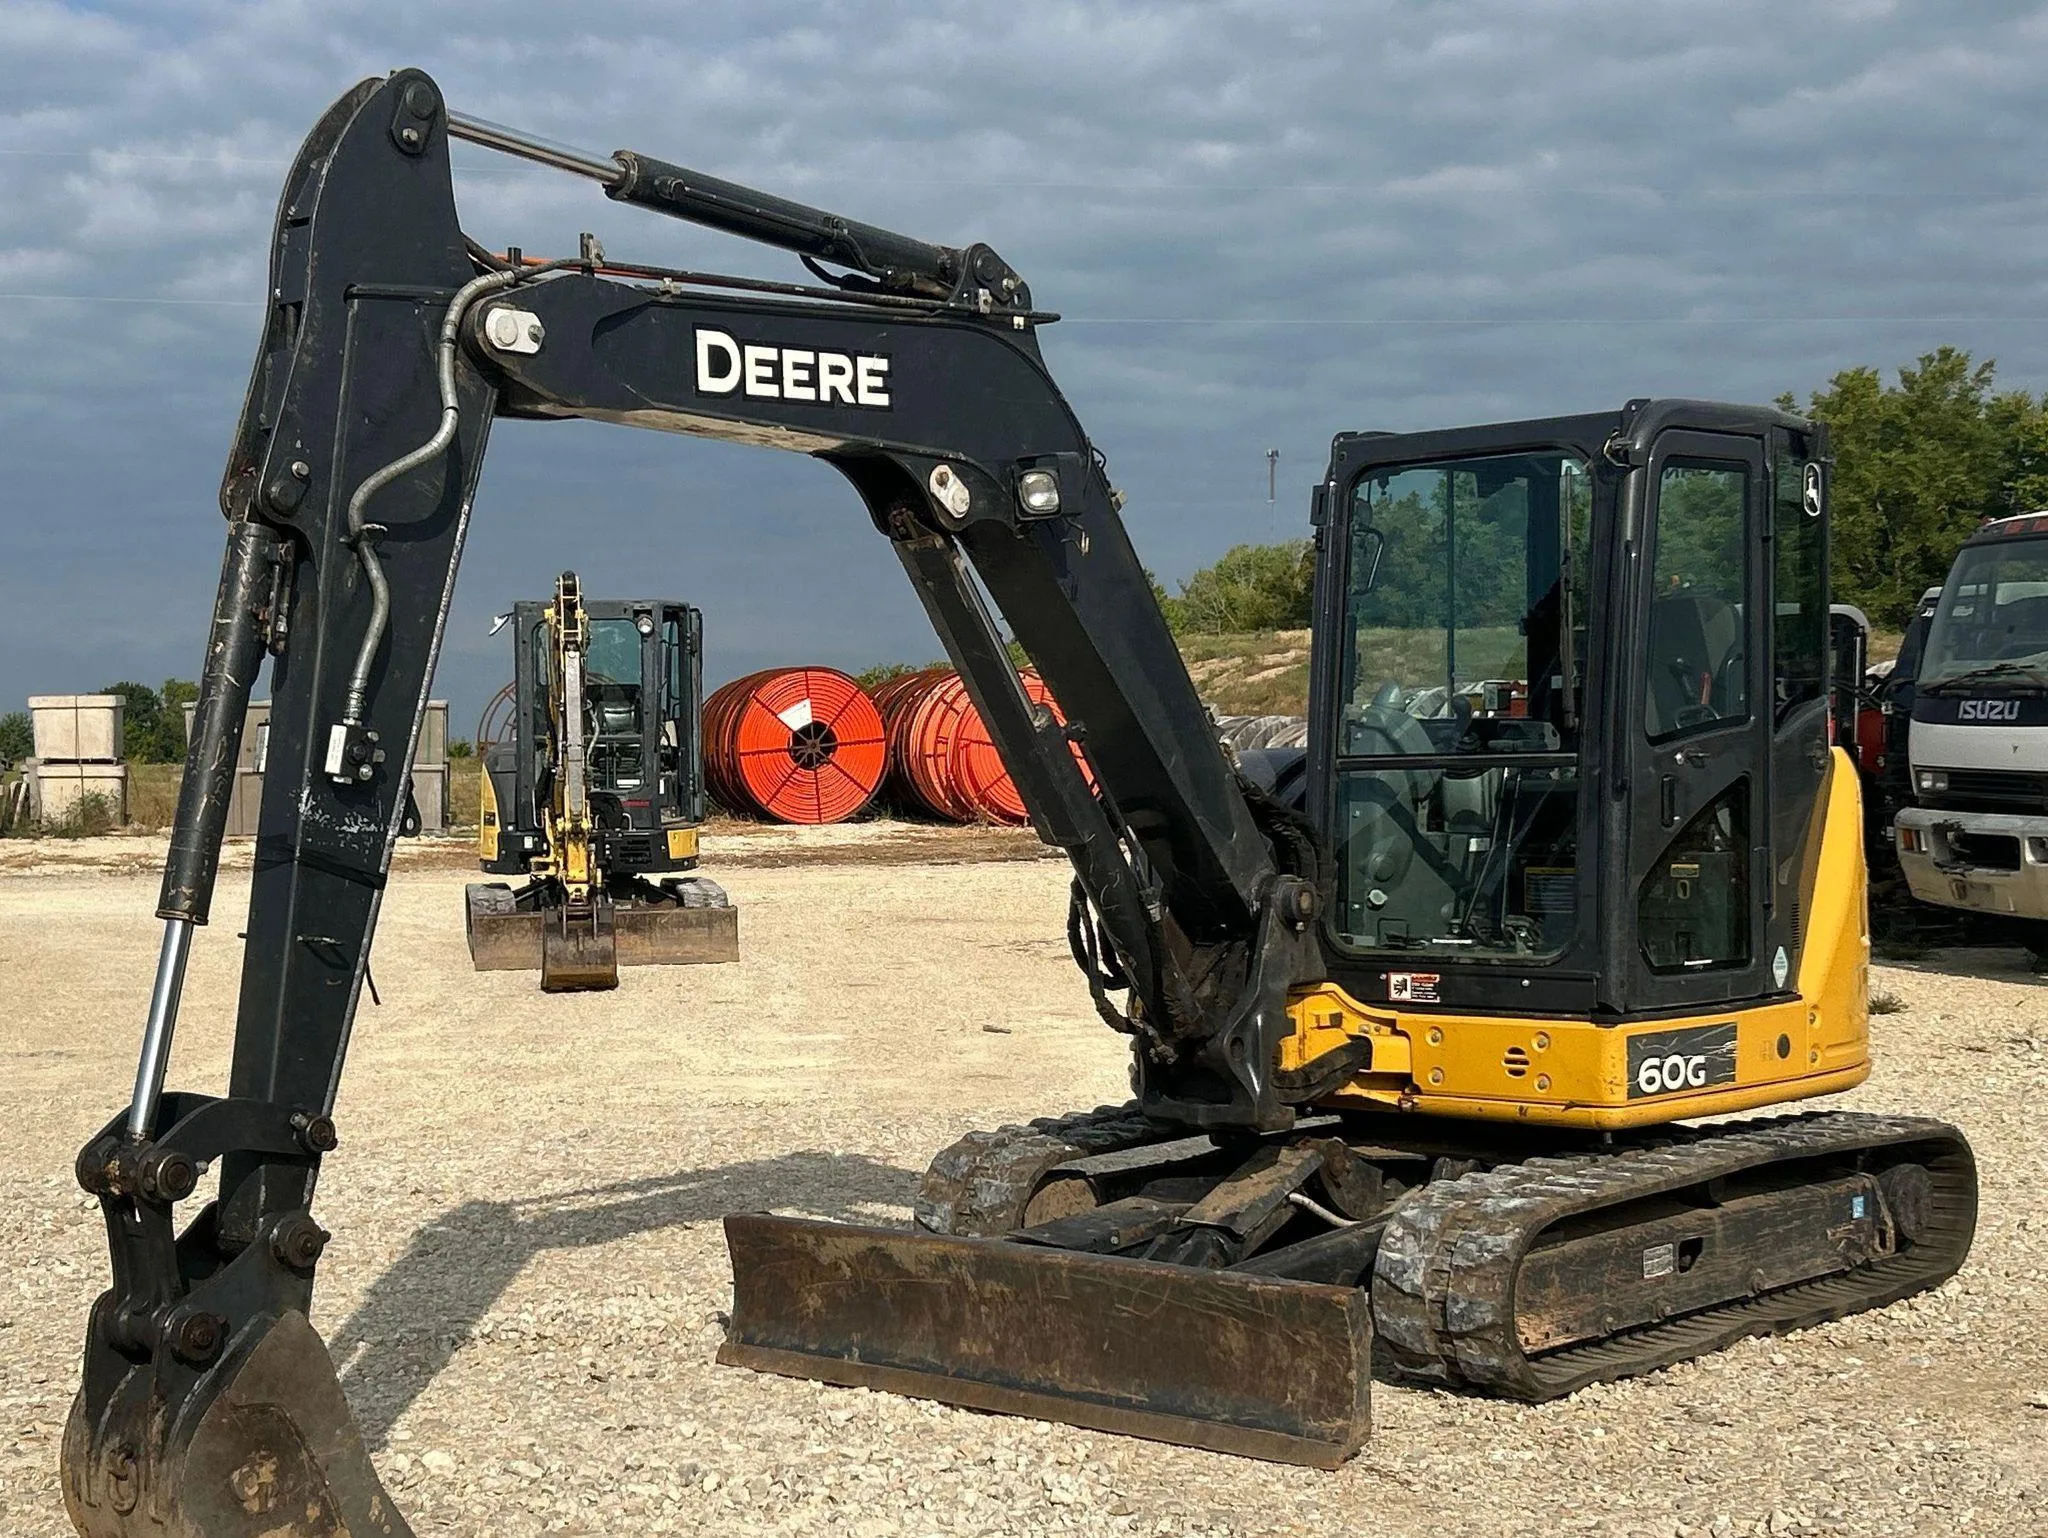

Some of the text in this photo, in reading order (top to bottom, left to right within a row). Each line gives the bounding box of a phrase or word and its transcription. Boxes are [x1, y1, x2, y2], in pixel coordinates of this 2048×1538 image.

[695, 328, 890, 407] DEERE
[1958, 700, 2021, 720] ISUZU
[1638, 1054, 1706, 1093] 60G
